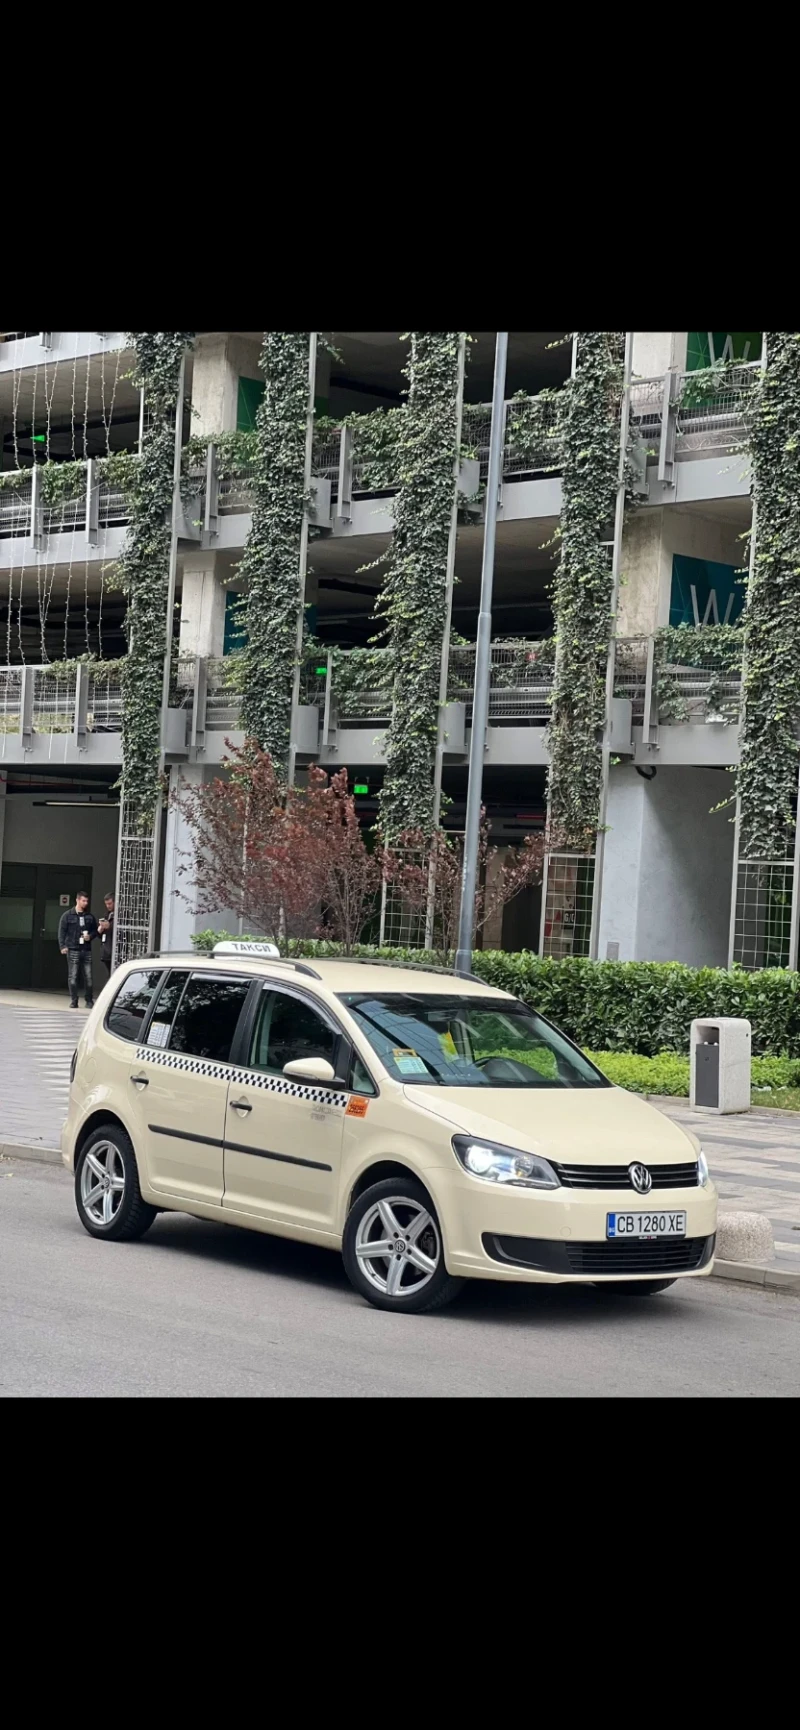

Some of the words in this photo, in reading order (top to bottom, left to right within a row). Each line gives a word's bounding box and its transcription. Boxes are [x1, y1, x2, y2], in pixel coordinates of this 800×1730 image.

[231, 943, 271, 953] ТАКСИ
[617, 1216, 635, 1233] CB
[637, 1215, 666, 1233] 1280
[668, 1214, 684, 1232] XE
